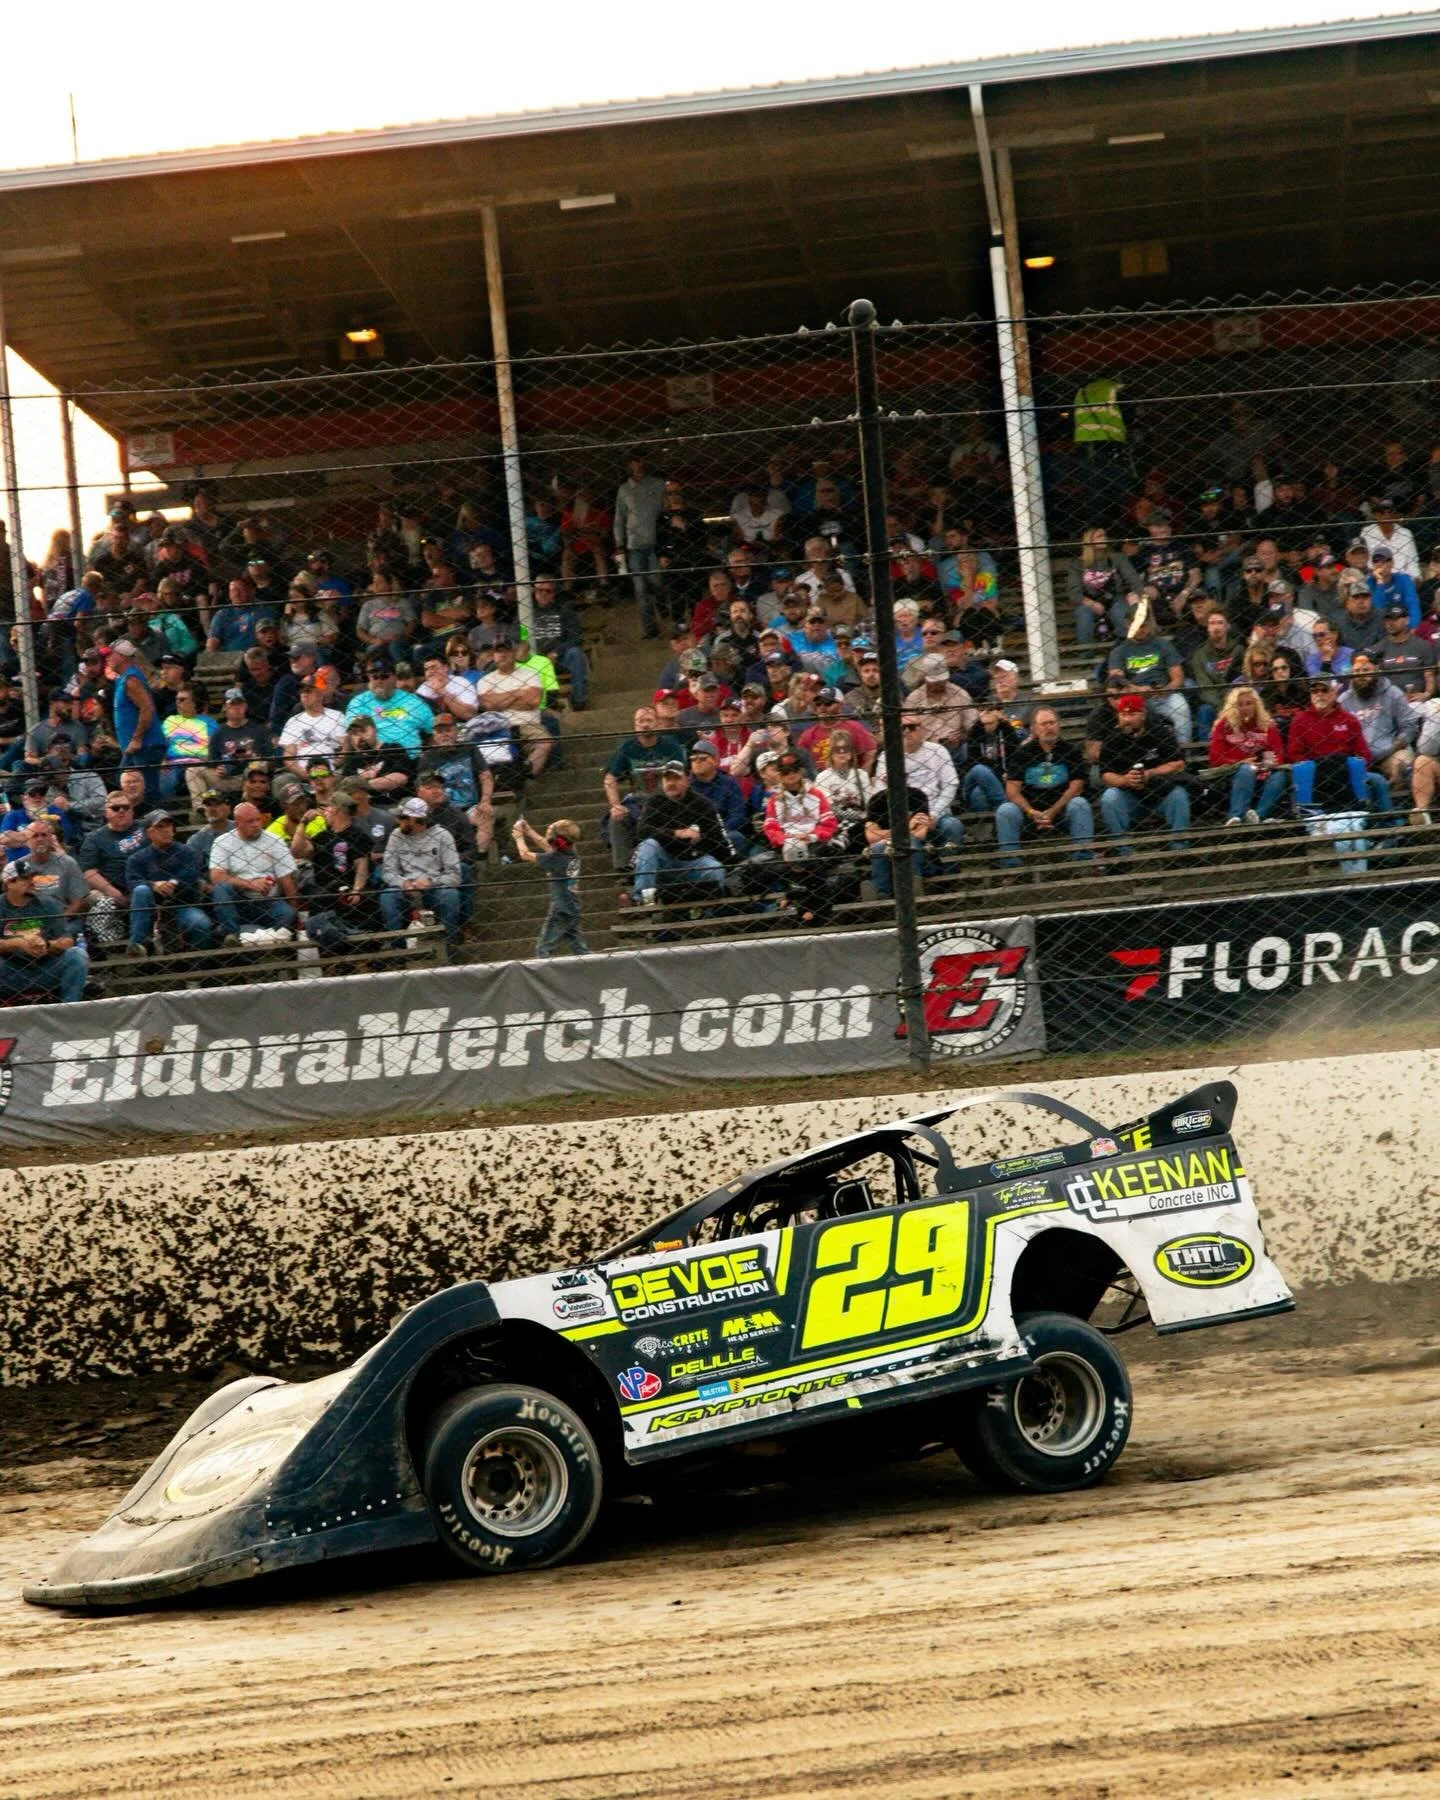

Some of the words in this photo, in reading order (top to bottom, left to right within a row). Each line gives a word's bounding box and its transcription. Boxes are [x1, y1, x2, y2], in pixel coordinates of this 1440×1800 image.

[917, 927, 1000, 951] SPEEDWAY
[43, 984, 873, 1107] EldoraMerch.com
[1091, 1148, 1232, 1201] KEENAN
[1149, 1191, 1204, 1210] Concrete
[1207, 1184, 1234, 1202] INC.
[1166, 1246, 1221, 1266] THTI
[612, 1249, 764, 1310] DEVOE
[742, 1260, 757, 1272] INC
[801, 1200, 969, 1350] 29
[569, 1301, 598, 1311] Valvoline
[622, 1280, 769, 1322] CONSTRUCTION
[721, 1311, 782, 1338] M&M
[727, 1333, 748, 1343] HEAD
[750, 1326, 780, 1338] SERVICE
[670, 1347, 756, 1378] DELILLE
[618, 1367, 647, 1400] VP
[649, 1372, 848, 1432] KRYPTONITE
[702, 1385, 728, 1397] BILSTEIN
[516, 1398, 590, 1463] Hoosier
[1074, 1397, 1128, 1474] Hoosier
[440, 1503, 512, 1565] Hoosier
